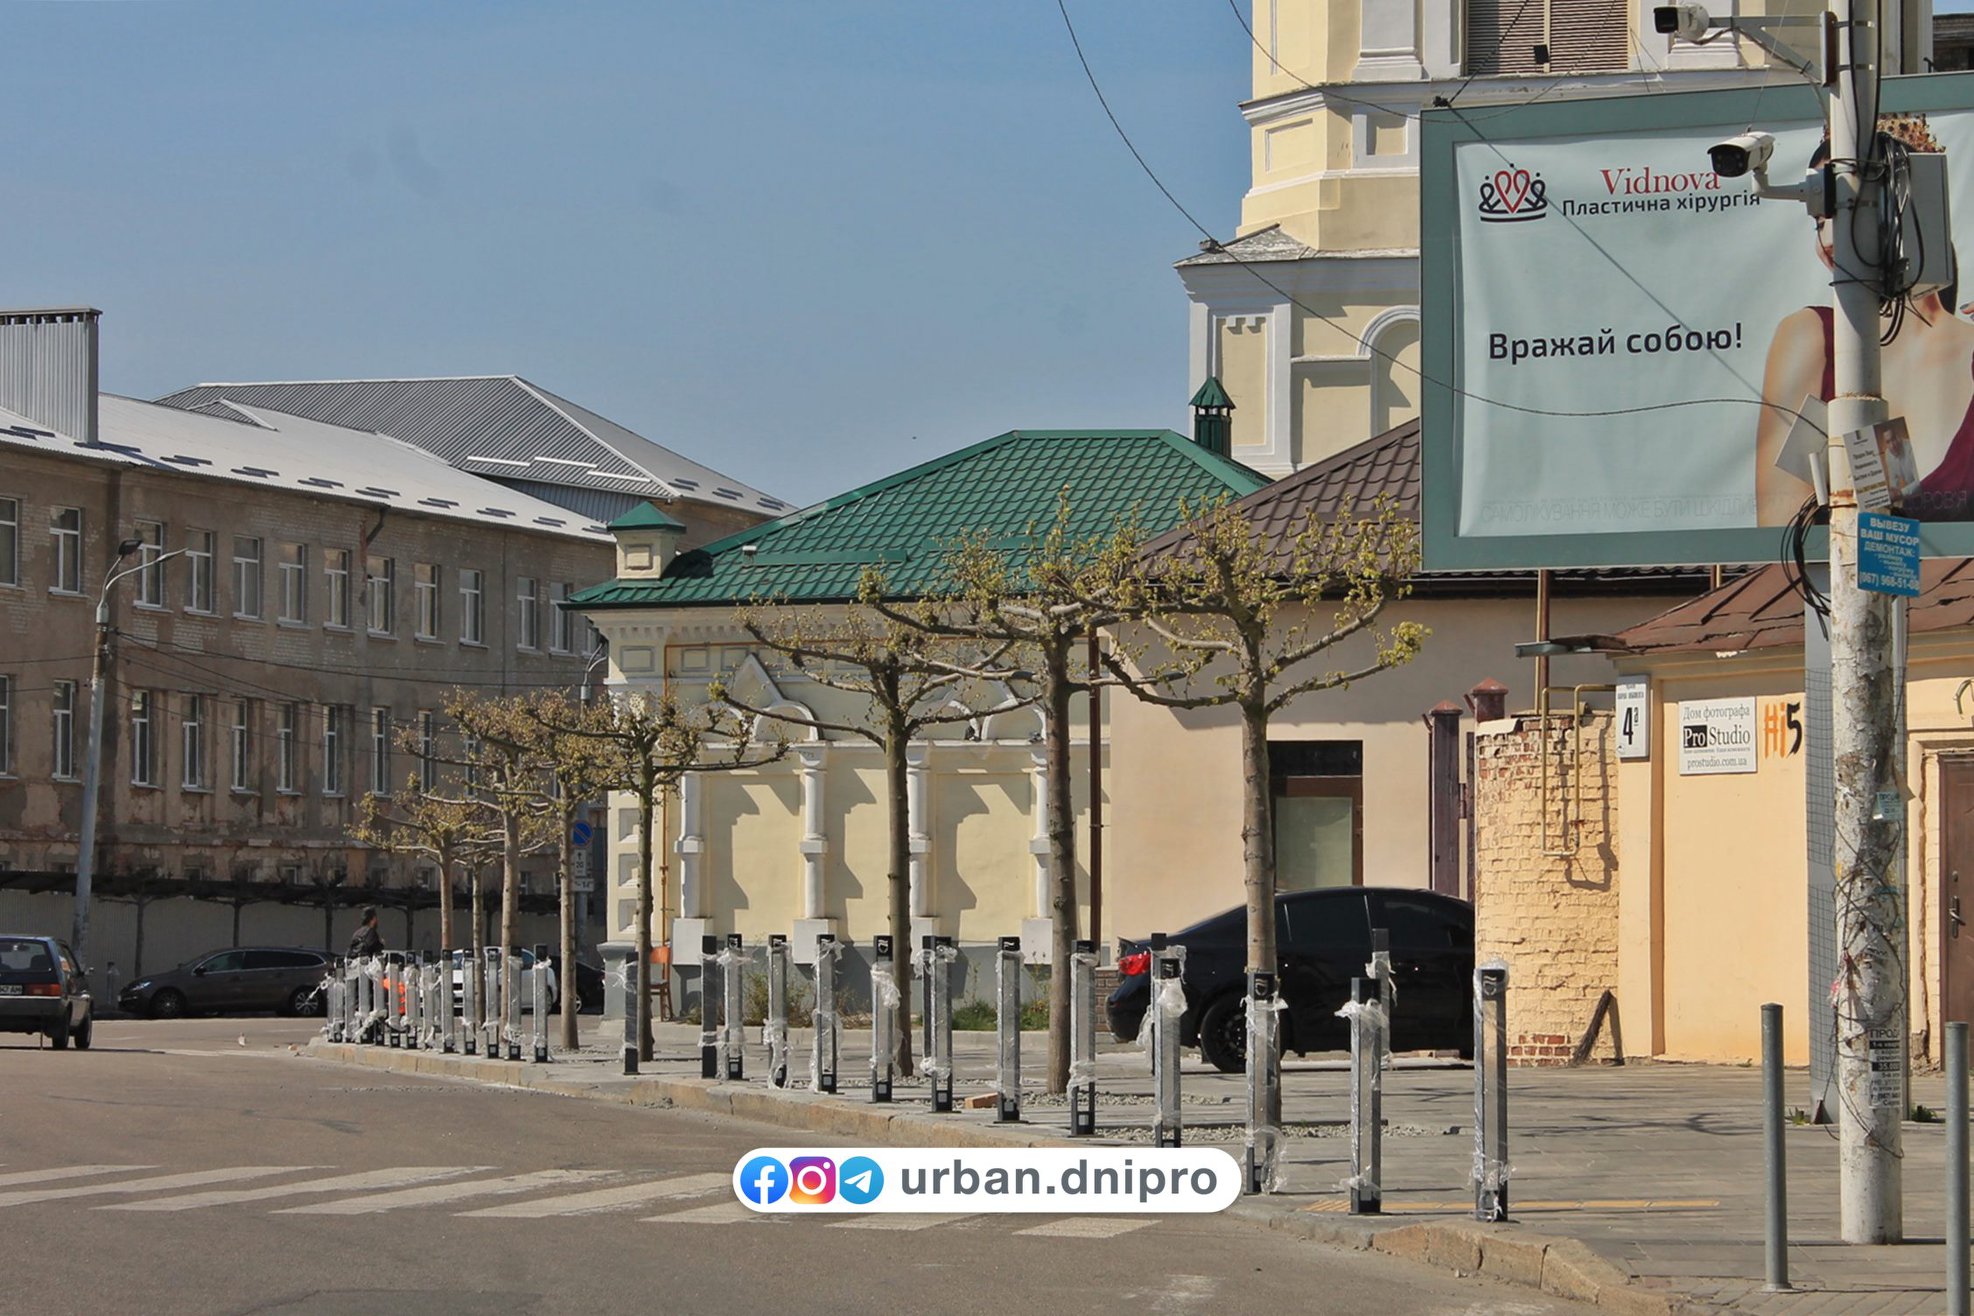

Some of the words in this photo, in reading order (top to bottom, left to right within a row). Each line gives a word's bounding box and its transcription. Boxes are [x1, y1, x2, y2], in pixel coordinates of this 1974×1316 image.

[1600, 166, 1722, 196] Vidnova
[1562, 196, 1671, 217] Пластична
[1675, 189, 1761, 214] хірургія
[1489, 326, 1617, 365] Вражай
[1626, 322, 1744, 355] собою!
[1870, 518, 1910, 533] ВЫВЕЗУ
[1860, 528, 1884, 540] ВАШ
[1886, 533, 1919, 546] МУСОР
[1683, 706, 1701, 720] Дом
[1703, 703, 1750, 721] фотографа
[1683, 727, 1706, 748] Pro
[1709, 724, 1751, 746] Studio
[1687, 756, 1748, 770] prostudio.com.ua
